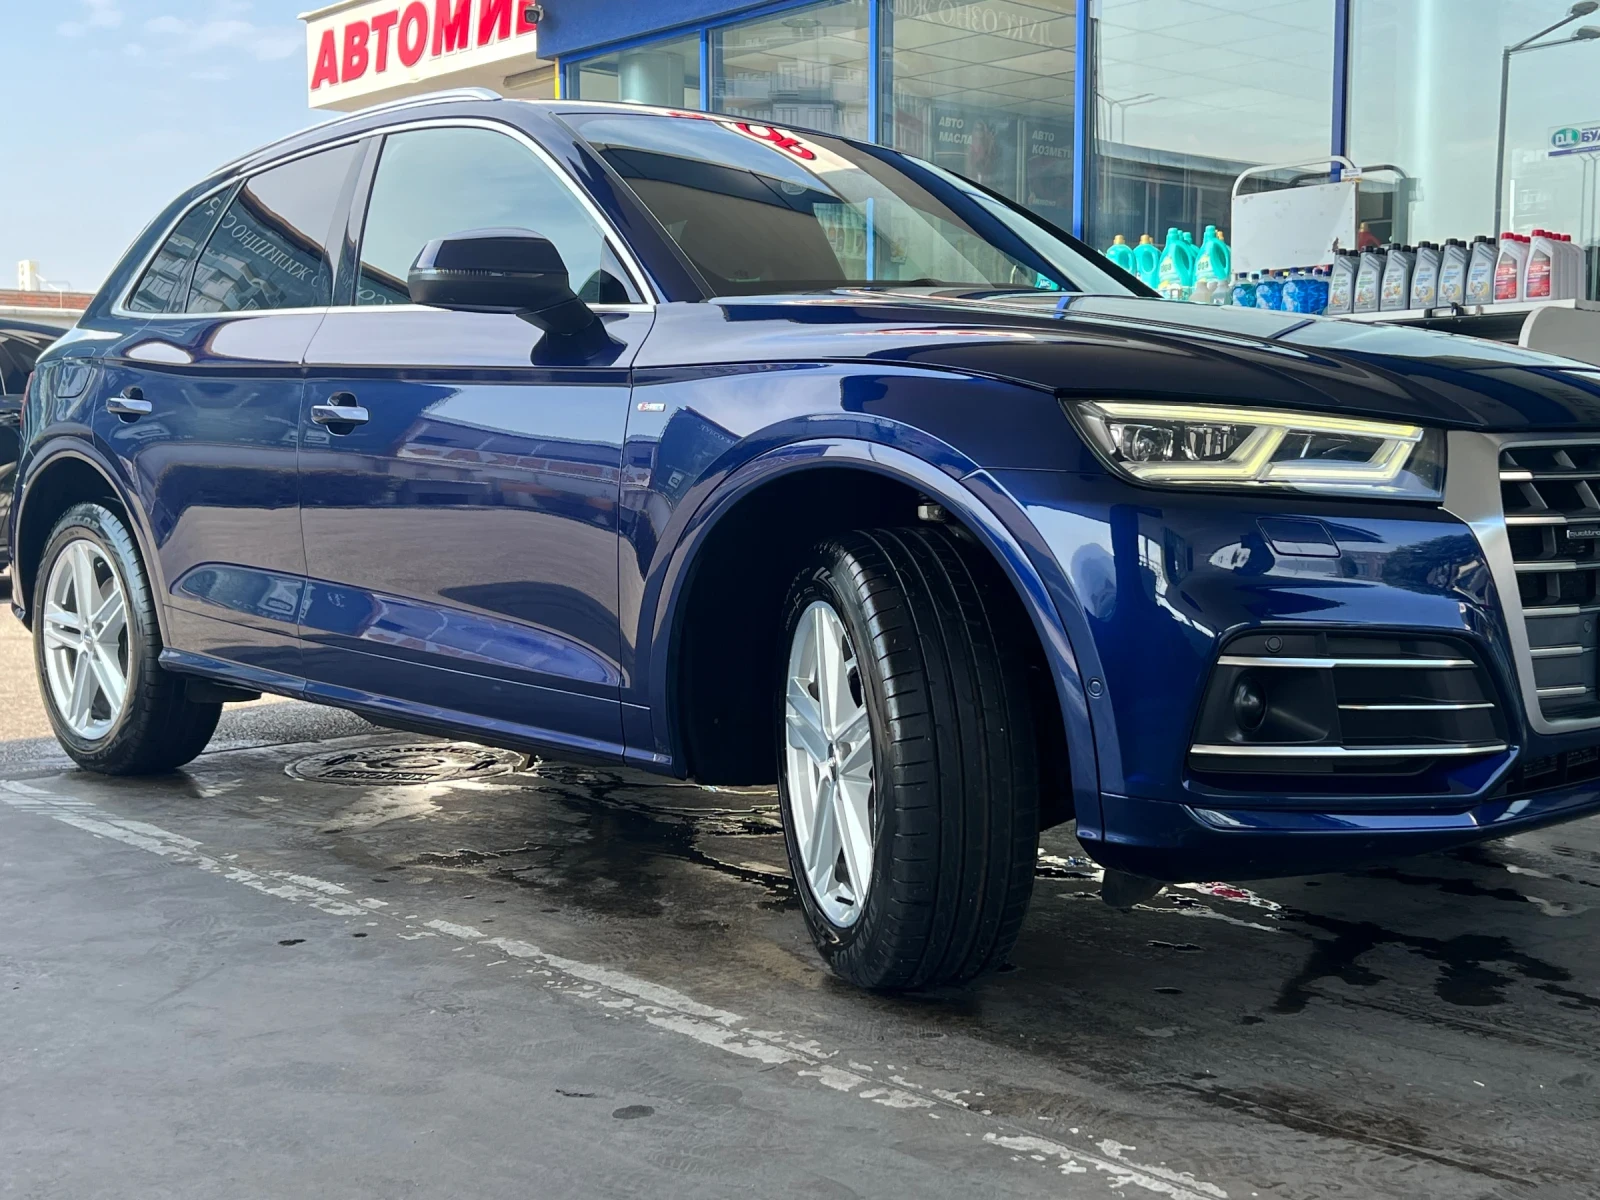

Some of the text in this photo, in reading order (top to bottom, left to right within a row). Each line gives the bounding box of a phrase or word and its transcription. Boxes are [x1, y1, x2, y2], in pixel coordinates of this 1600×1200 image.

[938, 116, 965, 129] АВТО
[939, 131, 973, 145] МАСЛА
[1032, 130, 1055, 142] АВТО
